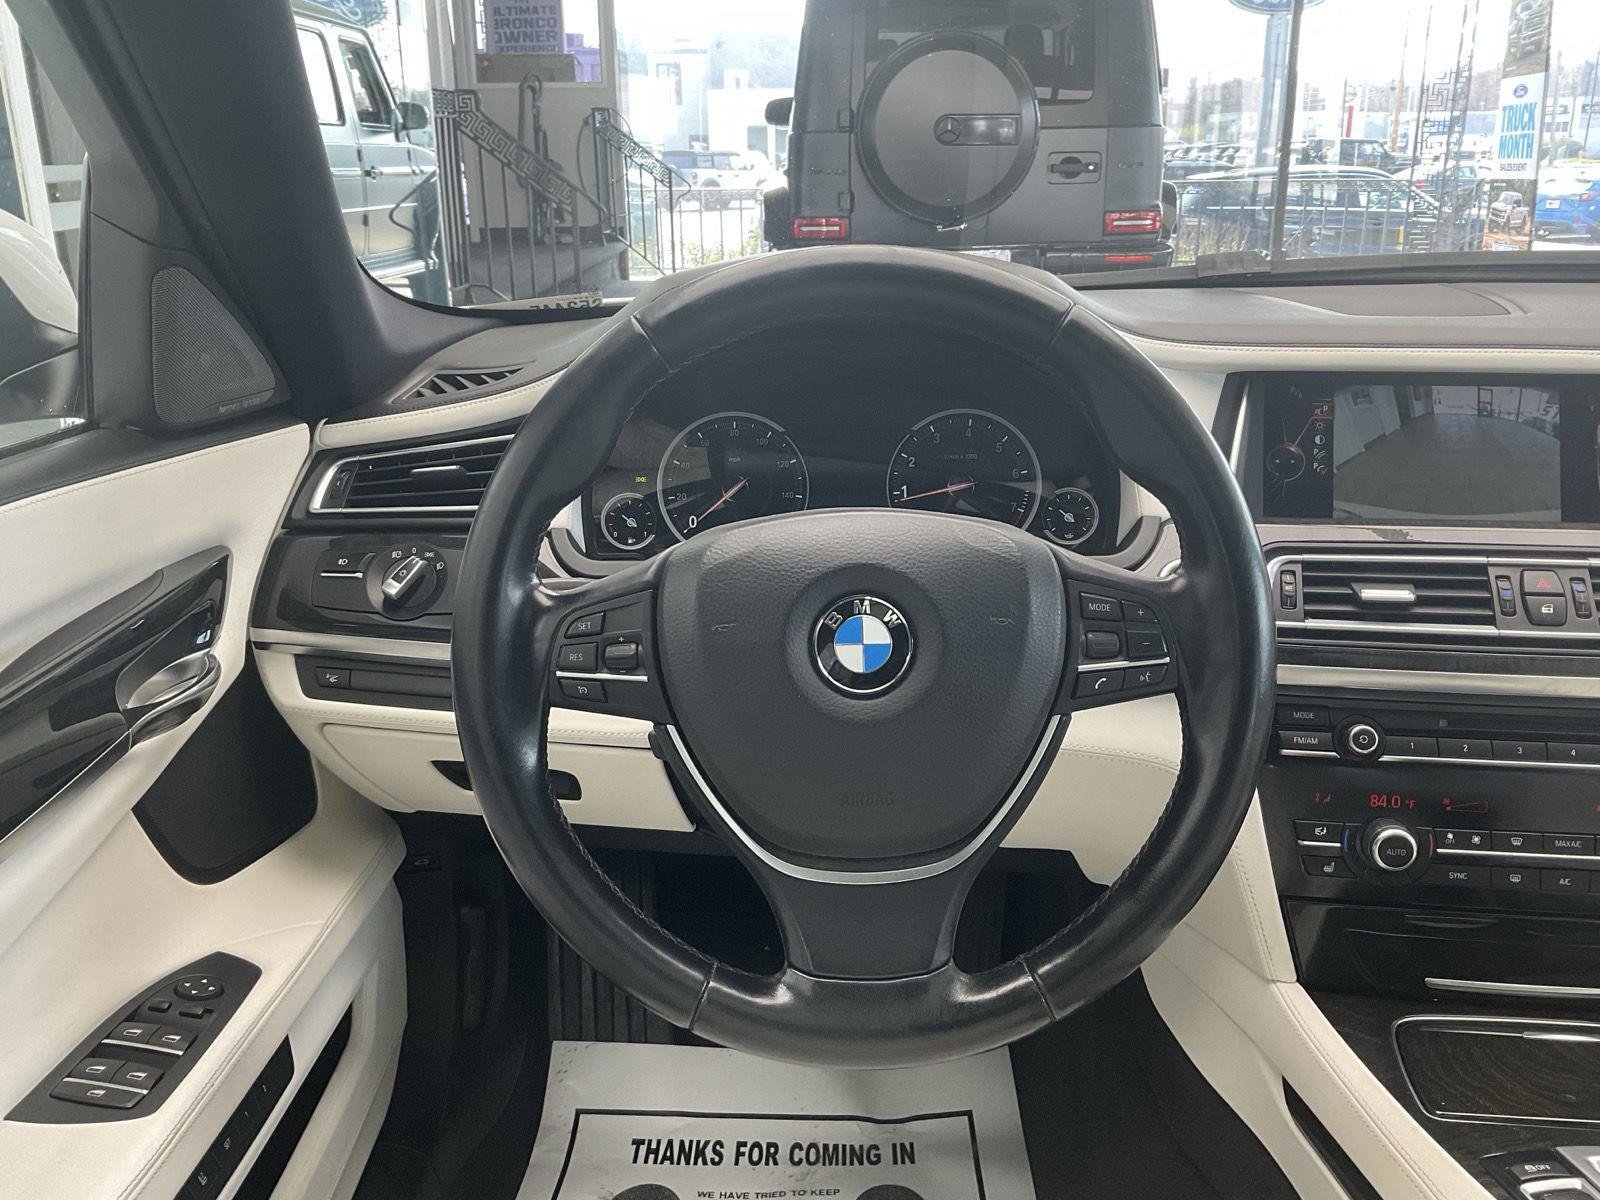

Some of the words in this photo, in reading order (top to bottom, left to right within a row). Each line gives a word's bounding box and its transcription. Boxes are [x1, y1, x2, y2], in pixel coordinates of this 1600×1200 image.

[1501, 102, 1537, 132] TRUCK
[1498, 133, 1534, 159] MONTH
[965, 429, 972, 437] 4
[933, 433, 940, 443] 3
[681, 461, 690, 469] 40
[909, 457, 915, 467] 2
[1012, 469, 1019, 478] 6
[901, 485, 907, 498] 1
[688, 515, 697, 528] 0
[1088, 603, 1111, 612] MODE
[825, 599, 901, 630] BMW
[578, 621, 591, 630] SET
[569, 653, 583, 661] RES
[1293, 711, 1315, 719] MODE
[1293, 736, 1318, 744] FM/AM
[1463, 744, 1468, 752] 2
[1517, 746, 1522, 754] 3
[1370, 794, 1401, 809] 84.0
[1386, 848, 1407, 856] AUTO
[1449, 872, 1468, 880] SYNC
[631, 1138, 724, 1166] THANKS
[734, 1140, 779, 1166] FOR
[789, 1142, 882, 1166] COMING
[891, 1142, 916, 1165] IN
[697, 1191, 715, 1199] WE
[719, 1191, 750, 1200] HAVE
[754, 1190, 787, 1199] TRIED
[791, 1189, 807, 1197] TO
[810, 1188, 840, 1197] KEEP
